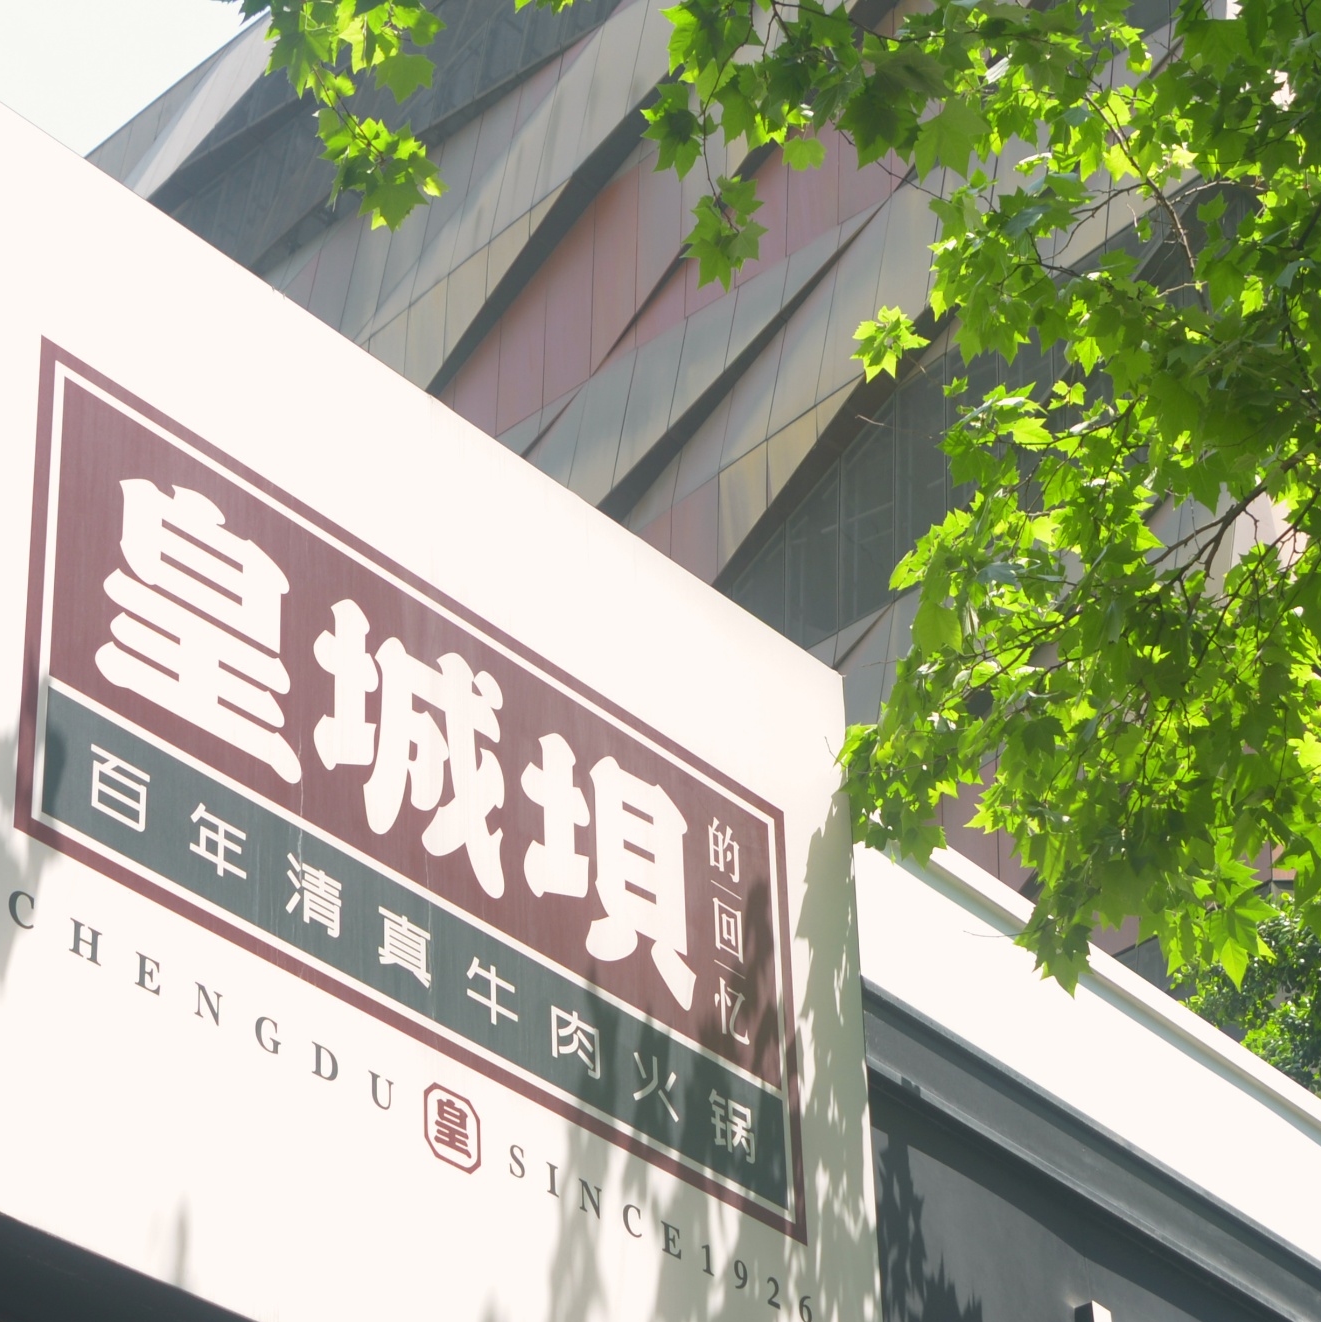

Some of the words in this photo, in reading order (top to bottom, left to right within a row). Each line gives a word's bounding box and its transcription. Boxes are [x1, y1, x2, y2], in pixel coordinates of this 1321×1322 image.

[8, 890, 395, 1111] CHENGDU
[91, 744, 756, 1164] 百年清真牛肉火锅
[708, 817, 750, 1045] 的回忆
[434, 1098, 472, 1160] 皇
